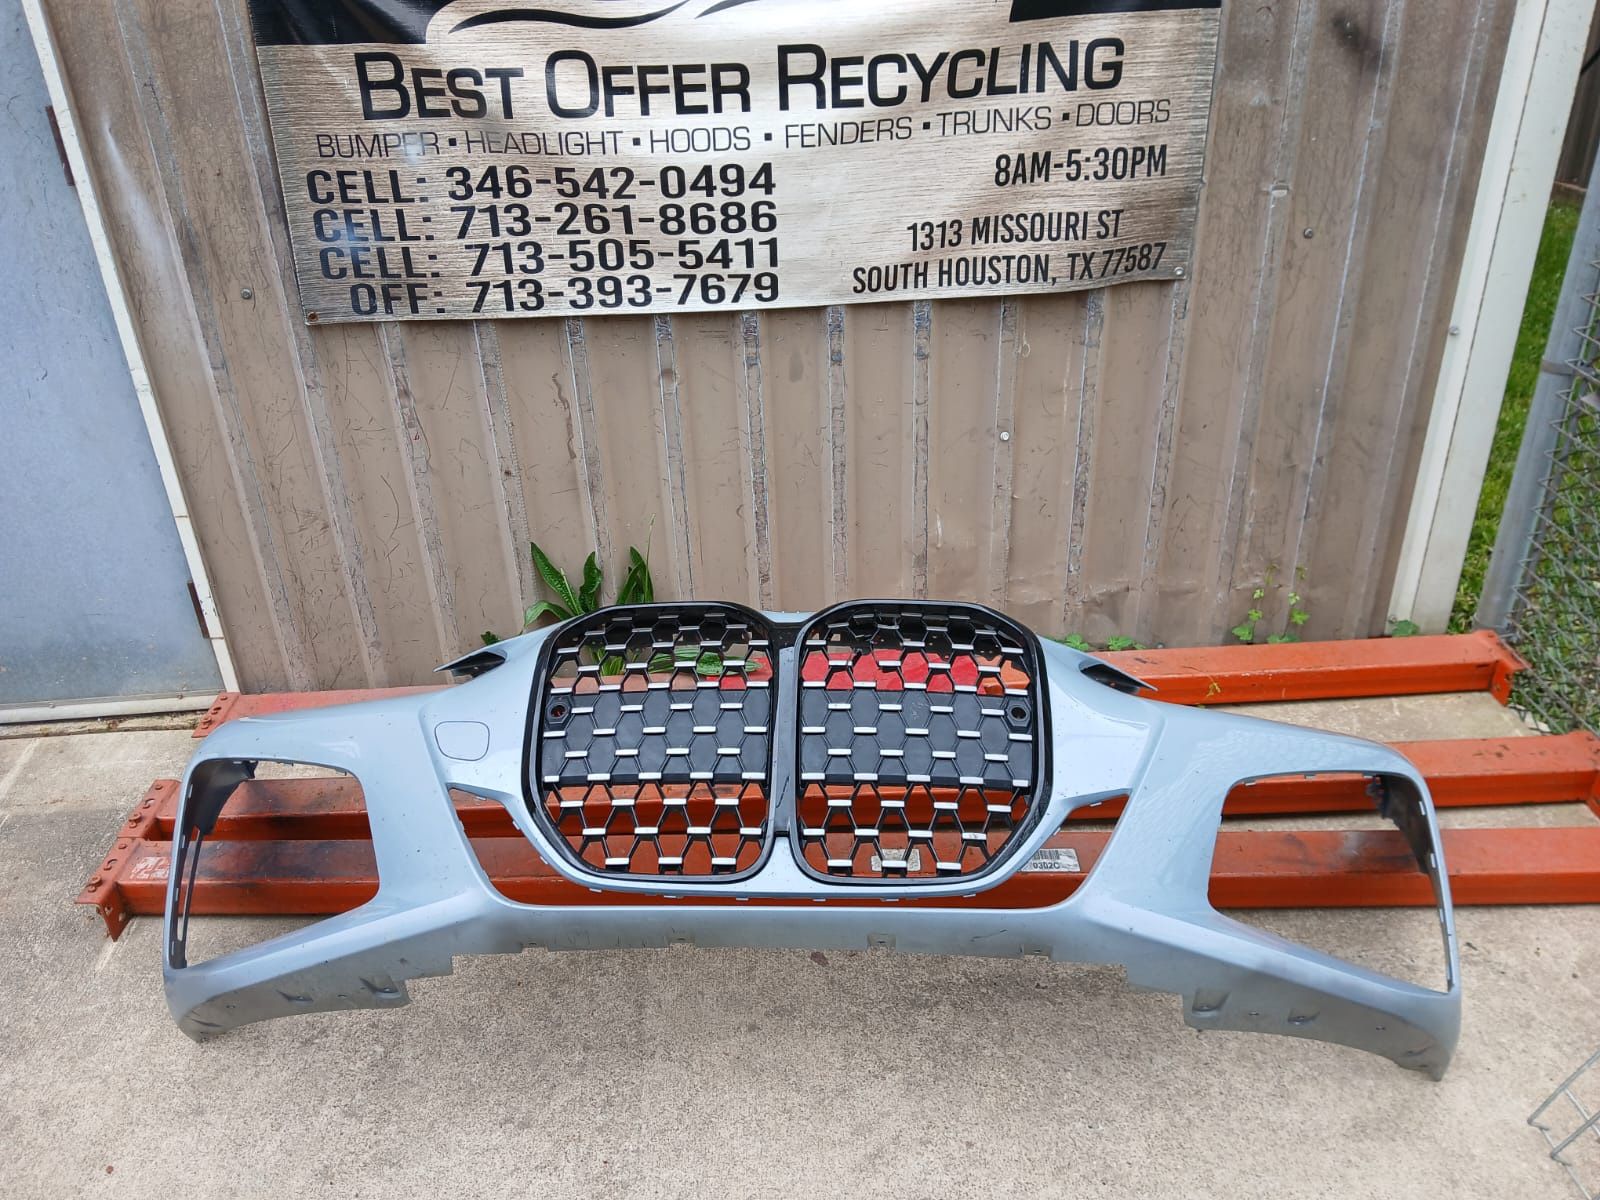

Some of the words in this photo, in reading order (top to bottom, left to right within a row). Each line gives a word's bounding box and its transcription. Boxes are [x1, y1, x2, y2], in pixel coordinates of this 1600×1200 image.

[317, 131, 440, 158] BUMPER
[466, 130, 624, 155] HEADLIGHT
[650, 125, 752, 154] HOODS
[784, 116, 913, 149] FENDERS
[936, 106, 1053, 137] TRUNKS
[1075, 99, 1172, 128] DOORS
[306, 169, 430, 205] CELL:
[445, 162, 777, 201] 346-542-0494
[994, 144, 1168, 187] 8AM-5:30PM
[313, 207, 435, 243] CELL:
[450, 200, 778, 240] 713-261-8686
[907, 219, 963, 252] 1313
[971, 210, 1089, 246] MISSOURI
[1096, 209, 1124, 240] ST
[318, 245, 440, 280] CELL:
[464, 237, 779, 276] 713-505-5411
[852, 262, 928, 295] SOUTH
[938, 253, 1057, 287] HOUSTON,
[1067, 251, 1094, 281] TX
[1099, 241, 1168, 278] 77587
[351, 282, 446, 317] OFF:
[465, 271, 779, 313] 713-393-7679
